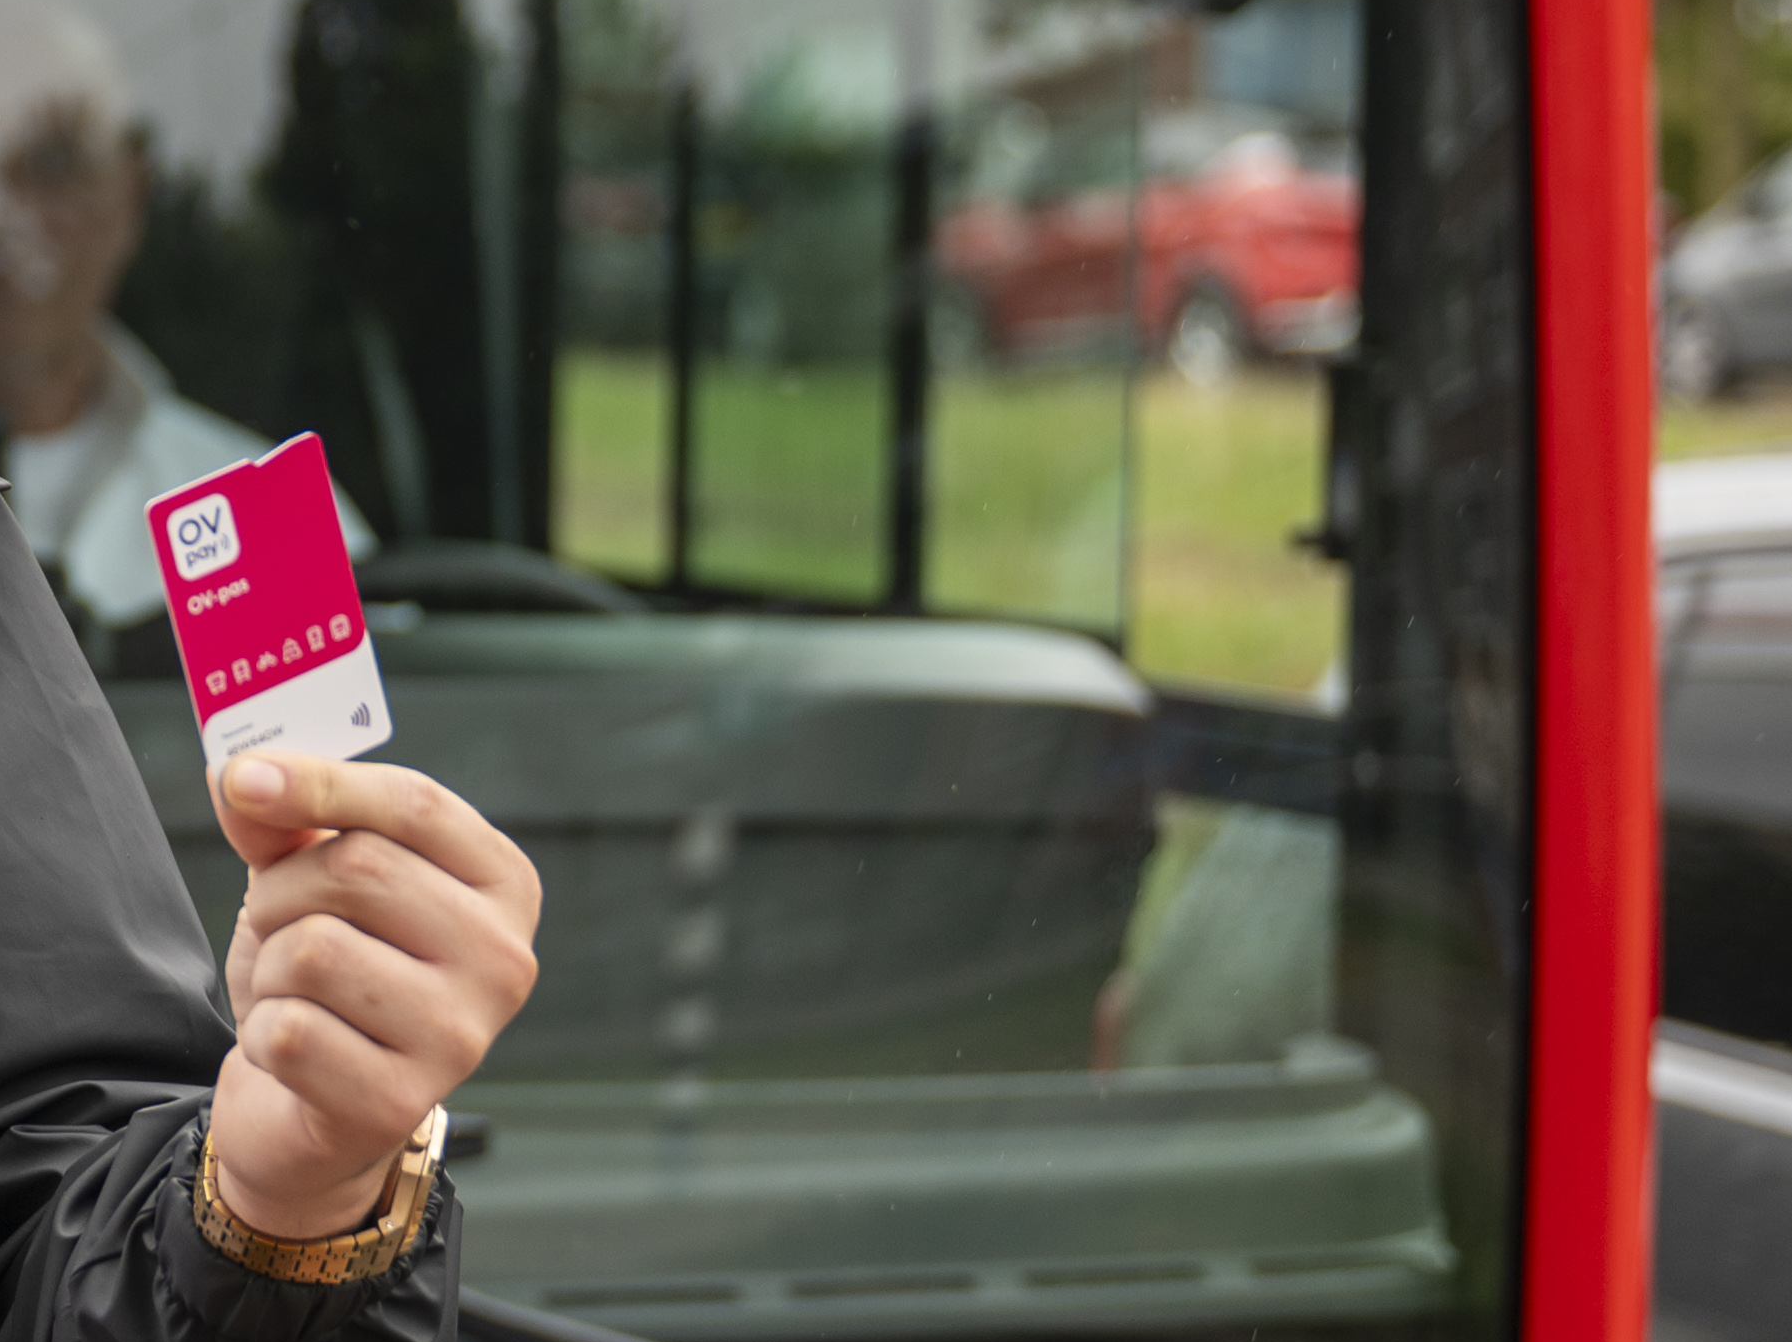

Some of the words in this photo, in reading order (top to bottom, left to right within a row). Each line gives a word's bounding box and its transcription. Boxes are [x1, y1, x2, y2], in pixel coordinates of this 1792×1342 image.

[178, 506, 221, 545] OV
[185, 541, 219, 568] pay
[186, 577, 251, 616] OV-pas
